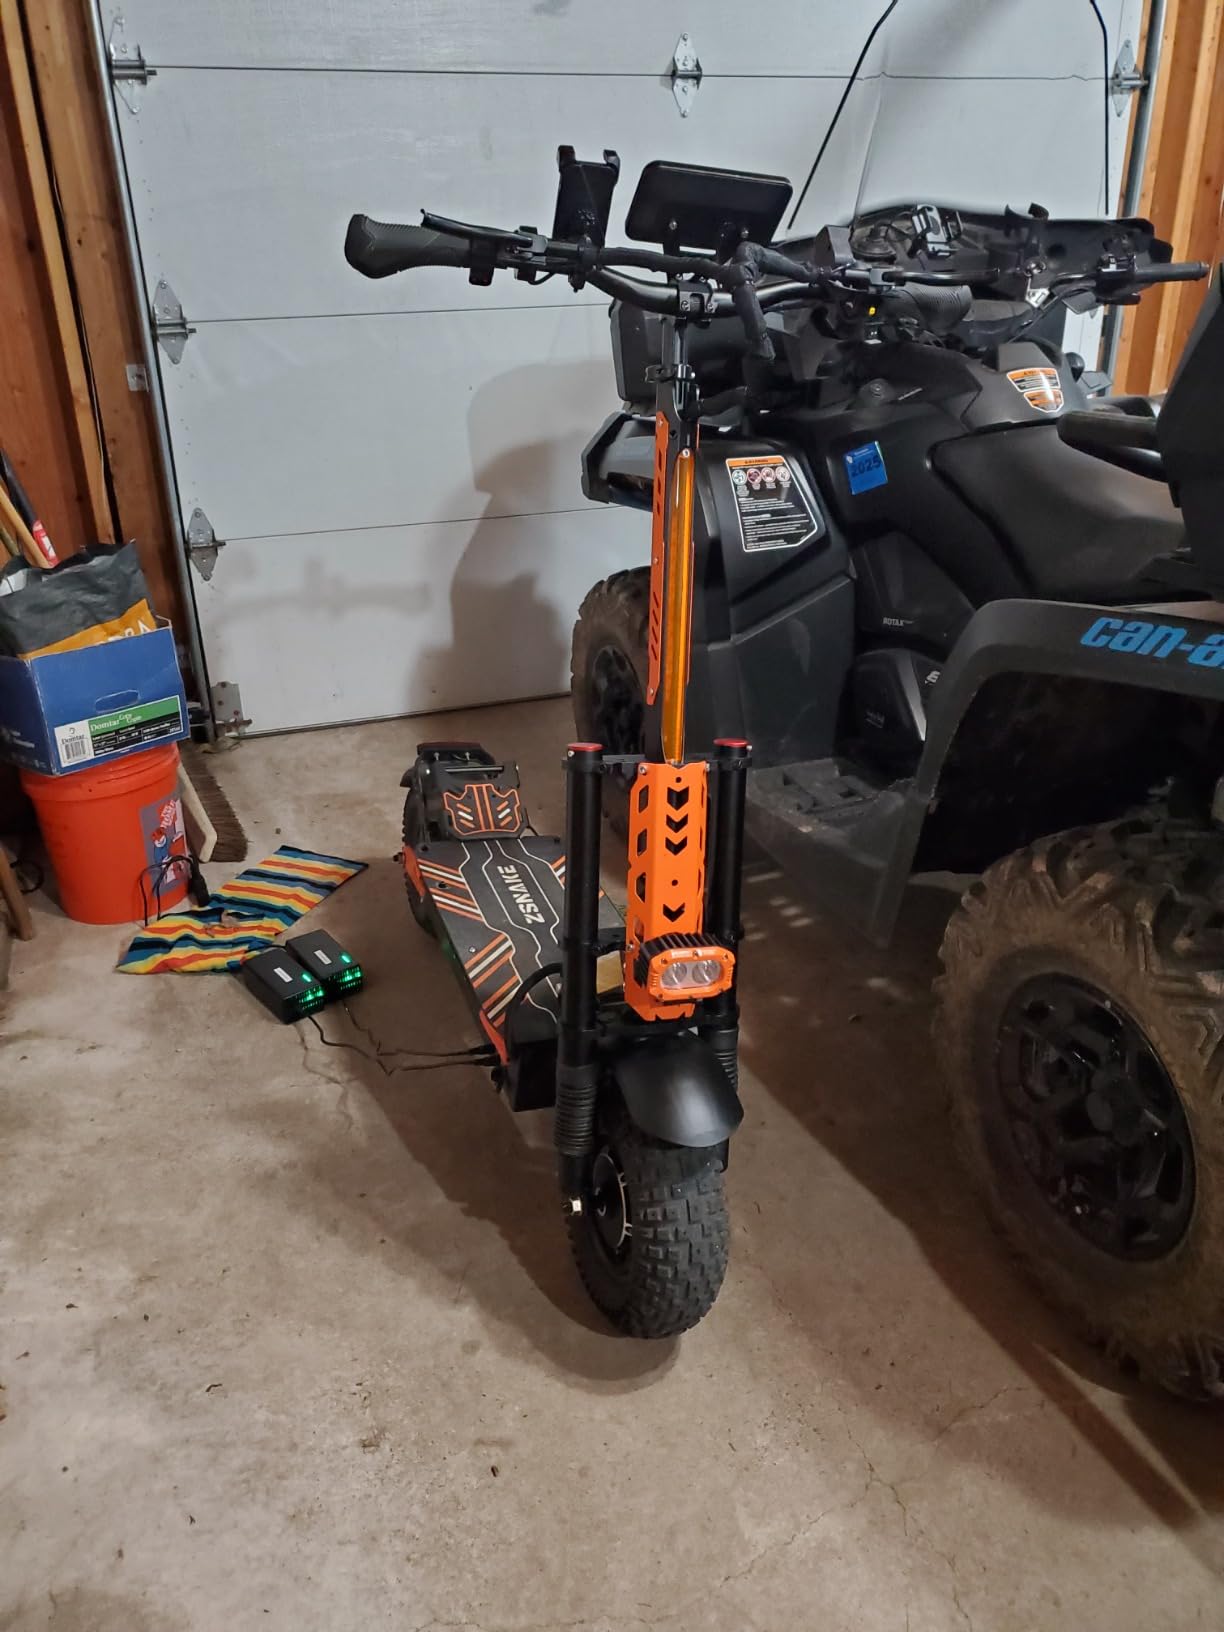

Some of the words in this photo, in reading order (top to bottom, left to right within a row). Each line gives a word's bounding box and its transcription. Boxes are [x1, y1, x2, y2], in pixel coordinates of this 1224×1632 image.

[851, 455, 881, 478] 2025
[1080, 616, 1224, 669] can-a
[90, 719, 120, 732] Domtar
[61, 734, 85, 745] Domtar
[497, 865, 545, 924] ZSNAKE
